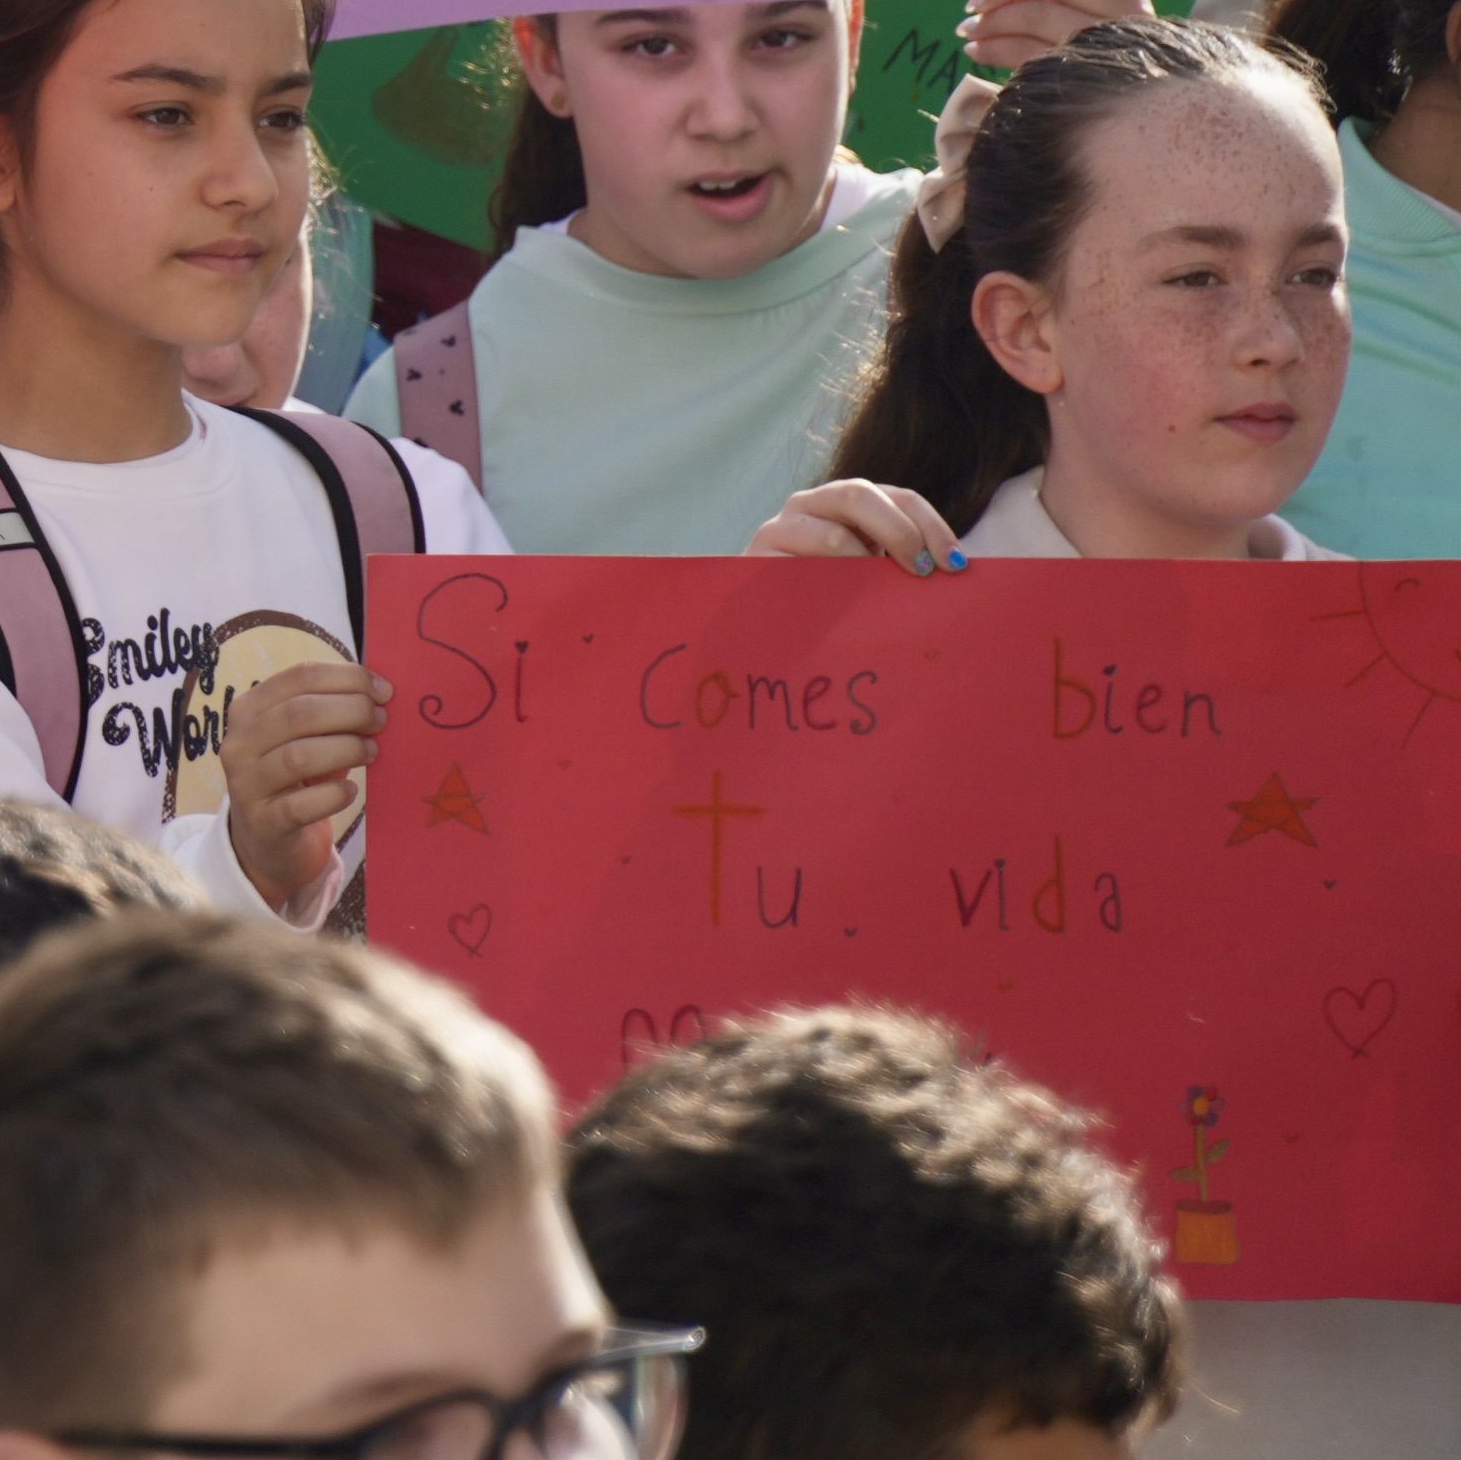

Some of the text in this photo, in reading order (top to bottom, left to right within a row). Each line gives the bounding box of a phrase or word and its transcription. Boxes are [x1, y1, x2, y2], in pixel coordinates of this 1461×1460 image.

[881, 27, 997, 94] MA
[416, 572, 530, 730] Si
[1052, 636, 1222, 738] bien
[101, 680, 261, 778] Worl
[949, 833, 1124, 934] vida
